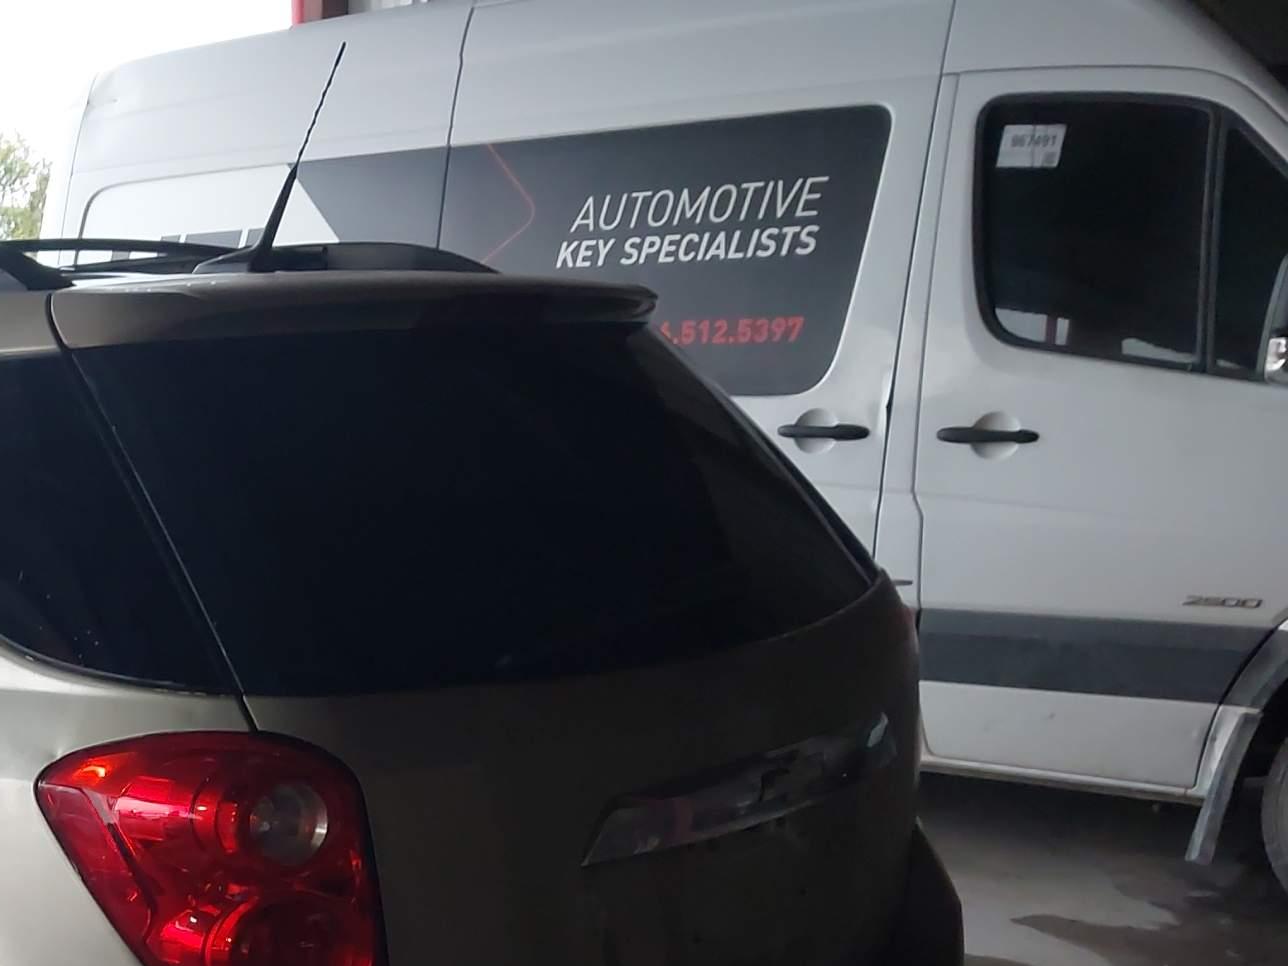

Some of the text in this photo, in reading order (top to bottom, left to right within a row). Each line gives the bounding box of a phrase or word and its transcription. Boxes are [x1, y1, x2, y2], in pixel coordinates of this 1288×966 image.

[570, 176, 830, 233] AUTOMOTIVE
[555, 225, 819, 269] KEY SPECIALISTS
